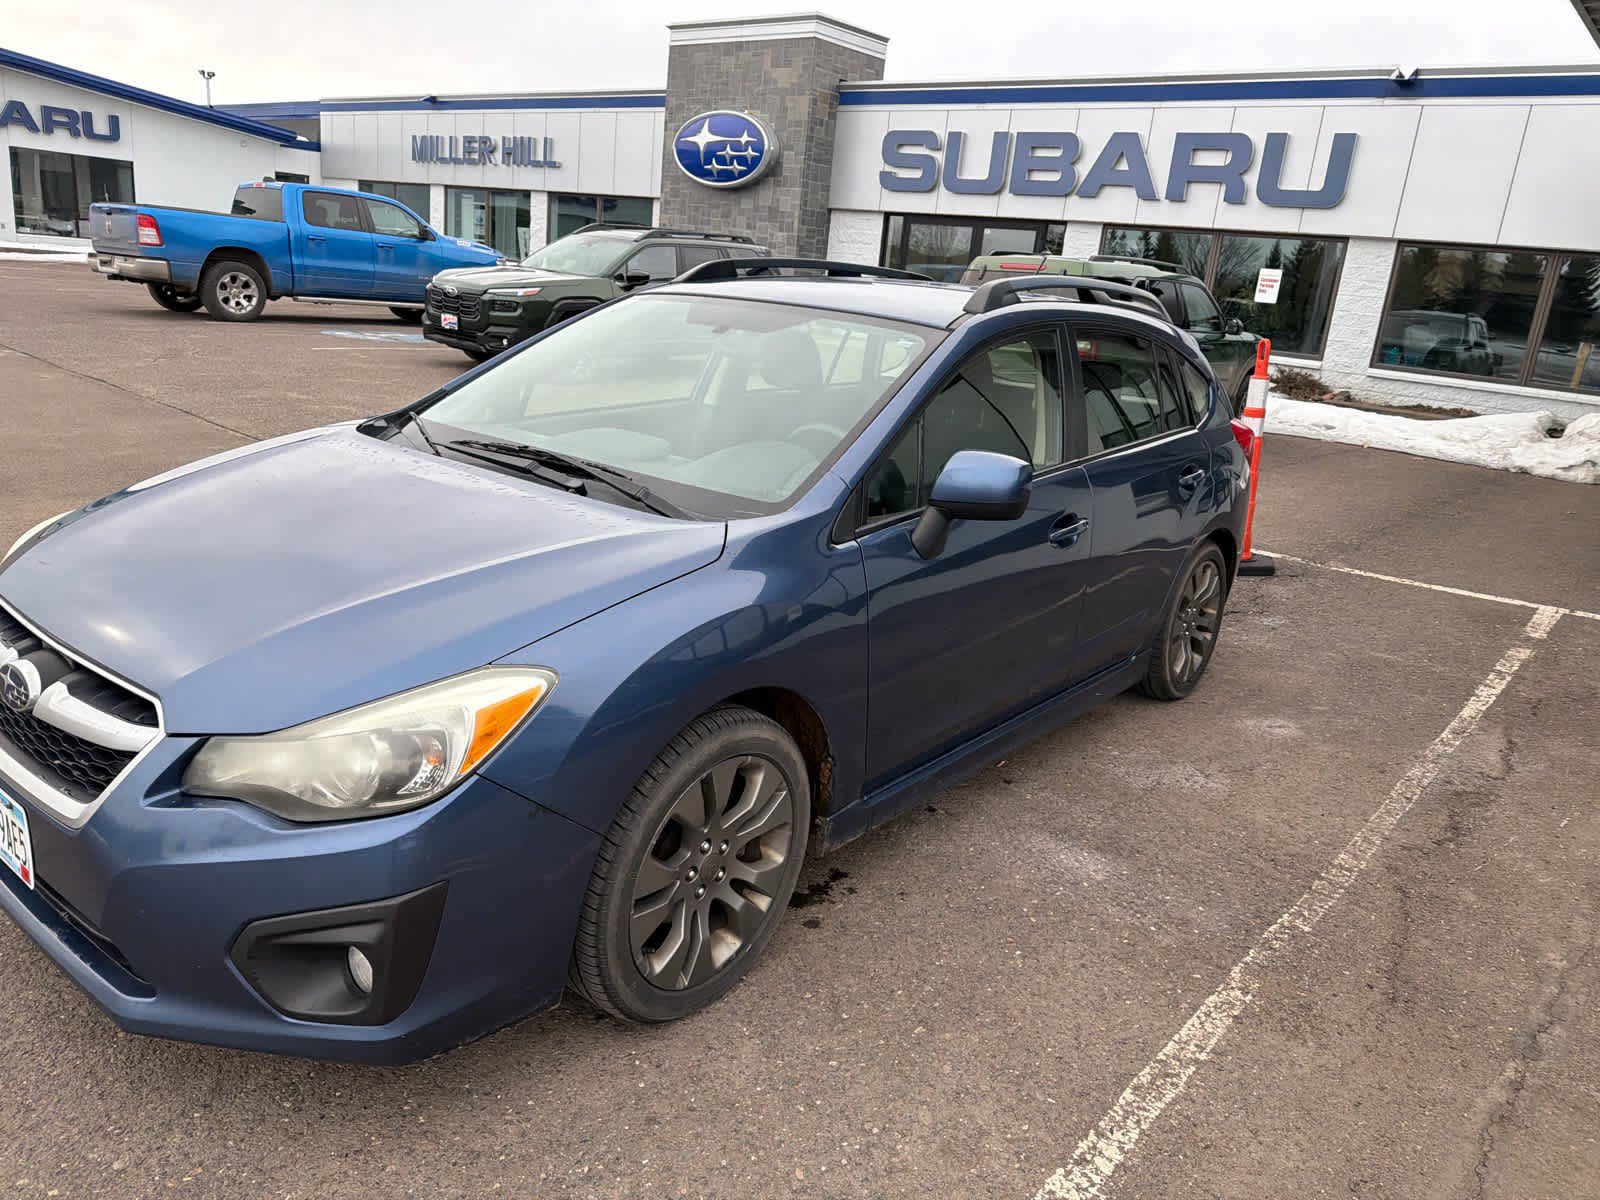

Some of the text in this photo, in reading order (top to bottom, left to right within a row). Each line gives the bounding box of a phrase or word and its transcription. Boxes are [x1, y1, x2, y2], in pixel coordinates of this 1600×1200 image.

[0, 100, 120, 142] ARU
[411, 135, 562, 168] MILLER HILL
[879, 130, 1359, 209] SUBARU
